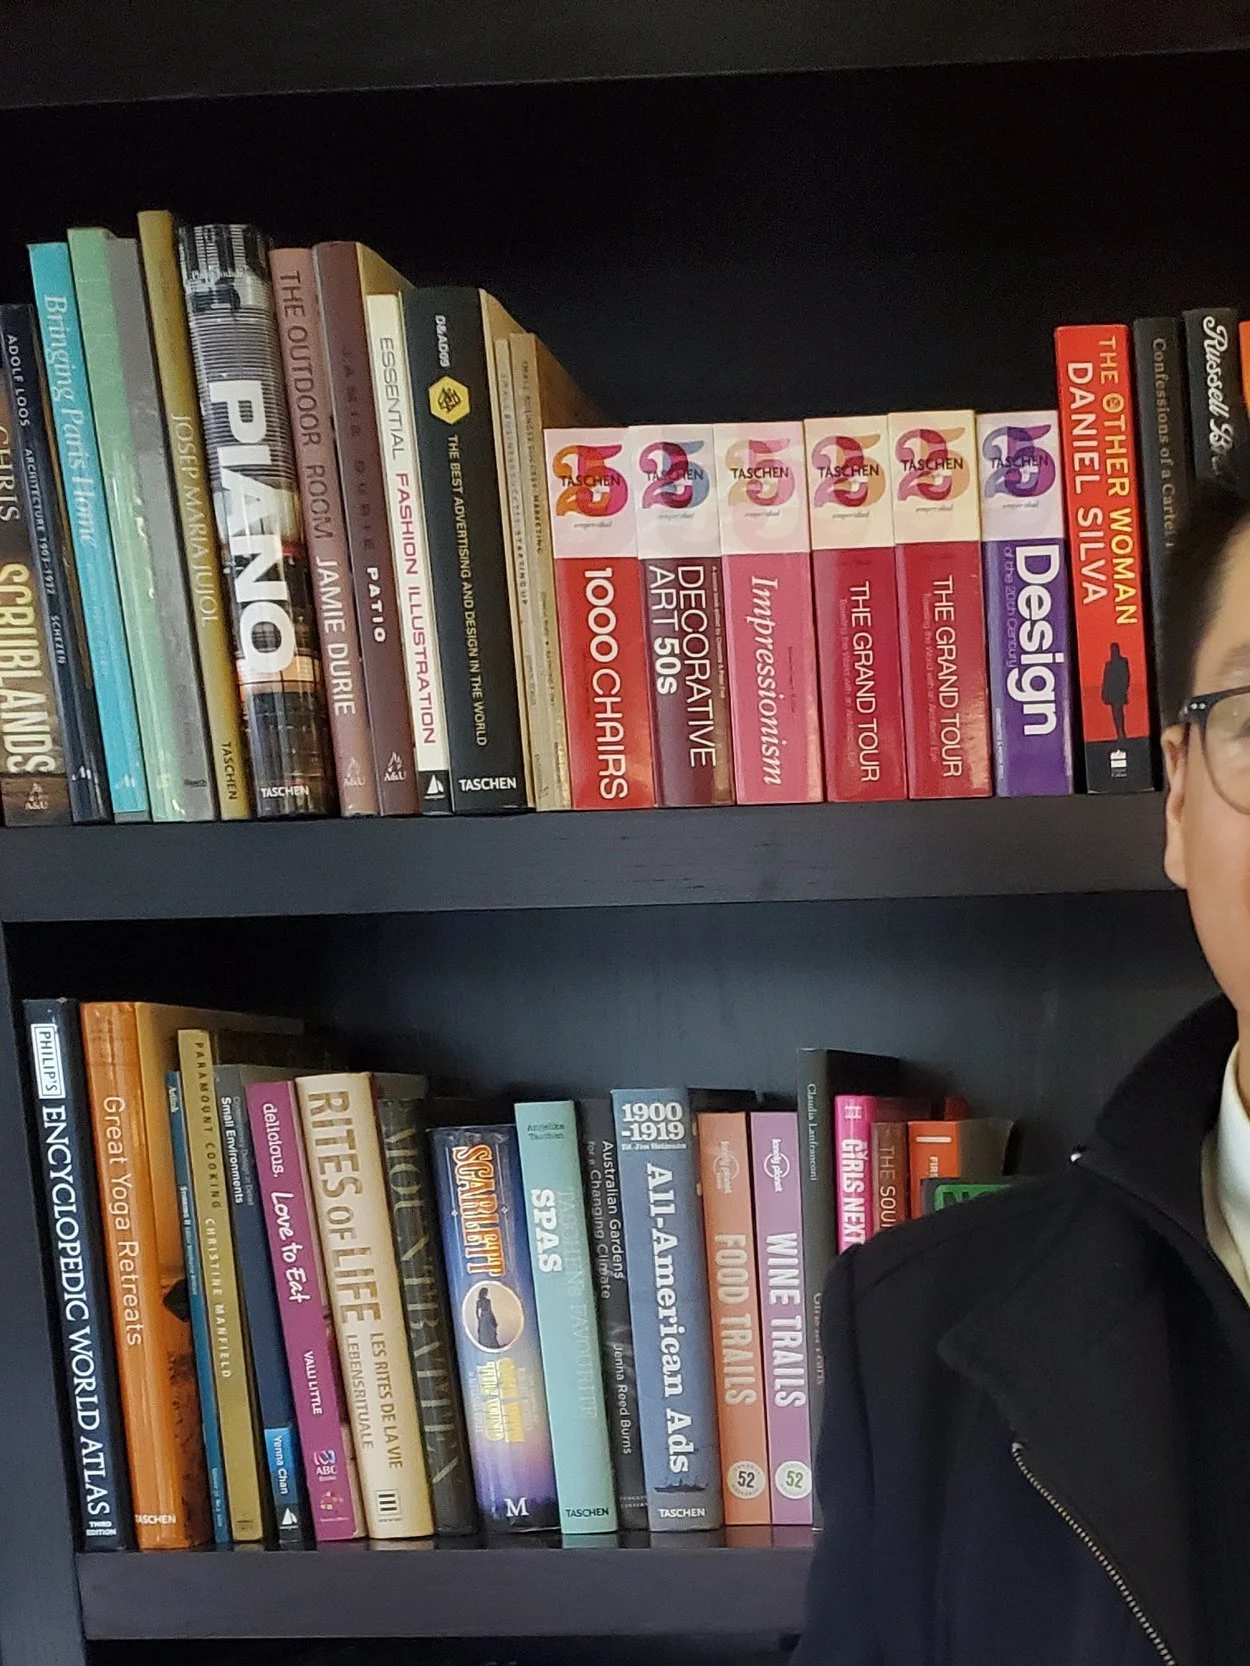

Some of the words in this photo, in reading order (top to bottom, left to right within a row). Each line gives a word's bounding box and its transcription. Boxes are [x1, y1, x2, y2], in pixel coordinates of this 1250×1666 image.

[280, 270, 304, 318] THE
[7, 334, 24, 384] ADOLF
[44, 295, 75, 401] Bringing
[1099, 336, 1119, 384] THE
[15, 389, 30, 427] LOOS
[287, 325, 321, 446] OUTDOOR
[380, 336, 404, 460] ESSENTIAL
[61, 407, 85, 470] Paris
[171, 414, 197, 479] JOSEP
[448, 434, 460, 458] THE
[1067, 362, 1104, 495] DANIEL
[1102, 392, 1130, 498] OTHER
[305, 463, 333, 540] ROOM
[450, 463, 463, 493] BEST
[731, 467, 790, 480] TASCHEN
[817, 464, 880, 479] TASCHEN
[72, 475, 96, 548] Home
[183, 487, 207, 562] MARIA
[209, 380, 296, 673] PIANO
[395, 472, 418, 575] FASHION
[453, 497, 472, 579] ADVERTISING
[1078, 506, 1109, 605] SILVA
[1109, 507, 1138, 625] WOMAN
[194, 565, 218, 628] JUJOL
[316, 556, 346, 633] JAMIE
[366, 566, 386, 643] PATIO
[461, 581, 474, 608] AND
[583, 566, 619, 663] 1000
[648, 565, 678, 632] ART
[849, 580, 871, 626] THE
[406, 586, 436, 744] ILLUSTRATION
[464, 611, 478, 657] DESIGN
[654, 637, 681, 695] 50s
[677, 565, 717, 767] DECORATIVE
[1006, 545, 1064, 736] Design
[326, 642, 356, 716] DURIE
[470, 676, 483, 699] THE
[746, 575, 784, 785] Impressionism
[853, 631, 877, 713] GRAND
[473, 701, 488, 747] WORLD
[592, 669, 628, 800] CHAIRS
[855, 717, 881, 782] TOUR
[261, 785, 310, 797] TASCHEN
[458, 776, 517, 792] TASCHEN
[39, 1030, 58, 1093] PHILIP'S
[103, 1096, 128, 1165] Great
[221, 1096, 234, 1126] Small
[308, 1091, 363, 1198] RITES
[621, 1122, 685, 1142] -1919
[622, 1103, 683, 1122] 1900
[108, 1173, 133, 1231] Yoga
[226, 1129, 244, 1204] Environments
[42, 1105, 89, 1321] ENCYCLOPEDIC
[271, 1191, 294, 1241] Love
[326, 1206, 358, 1243] OF
[452, 1145, 504, 1276] SCARLETT
[530, 1188, 562, 1273] SPAS
[283, 1243, 303, 1262] to
[285, 1267, 311, 1303] Eat
[332, 1247, 382, 1324] LIFE
[714, 1234, 749, 1307] FOOD
[766, 1232, 799, 1306] WINE
[118, 1241, 145, 1345] Retreats
[647, 1163, 684, 1398] All-American
[667, 1409, 695, 1475] Ads
[69, 1326, 100, 1431] WORLD
[720, 1314, 757, 1406] TRAILS
[768, 1314, 807, 1409] TRAILS
[80, 1436, 110, 1515] ATLAS
[272, 1435, 285, 1466] Yenna
[277, 1468, 289, 1494] Chan
[565, 1507, 609, 1518] TASCHEN
